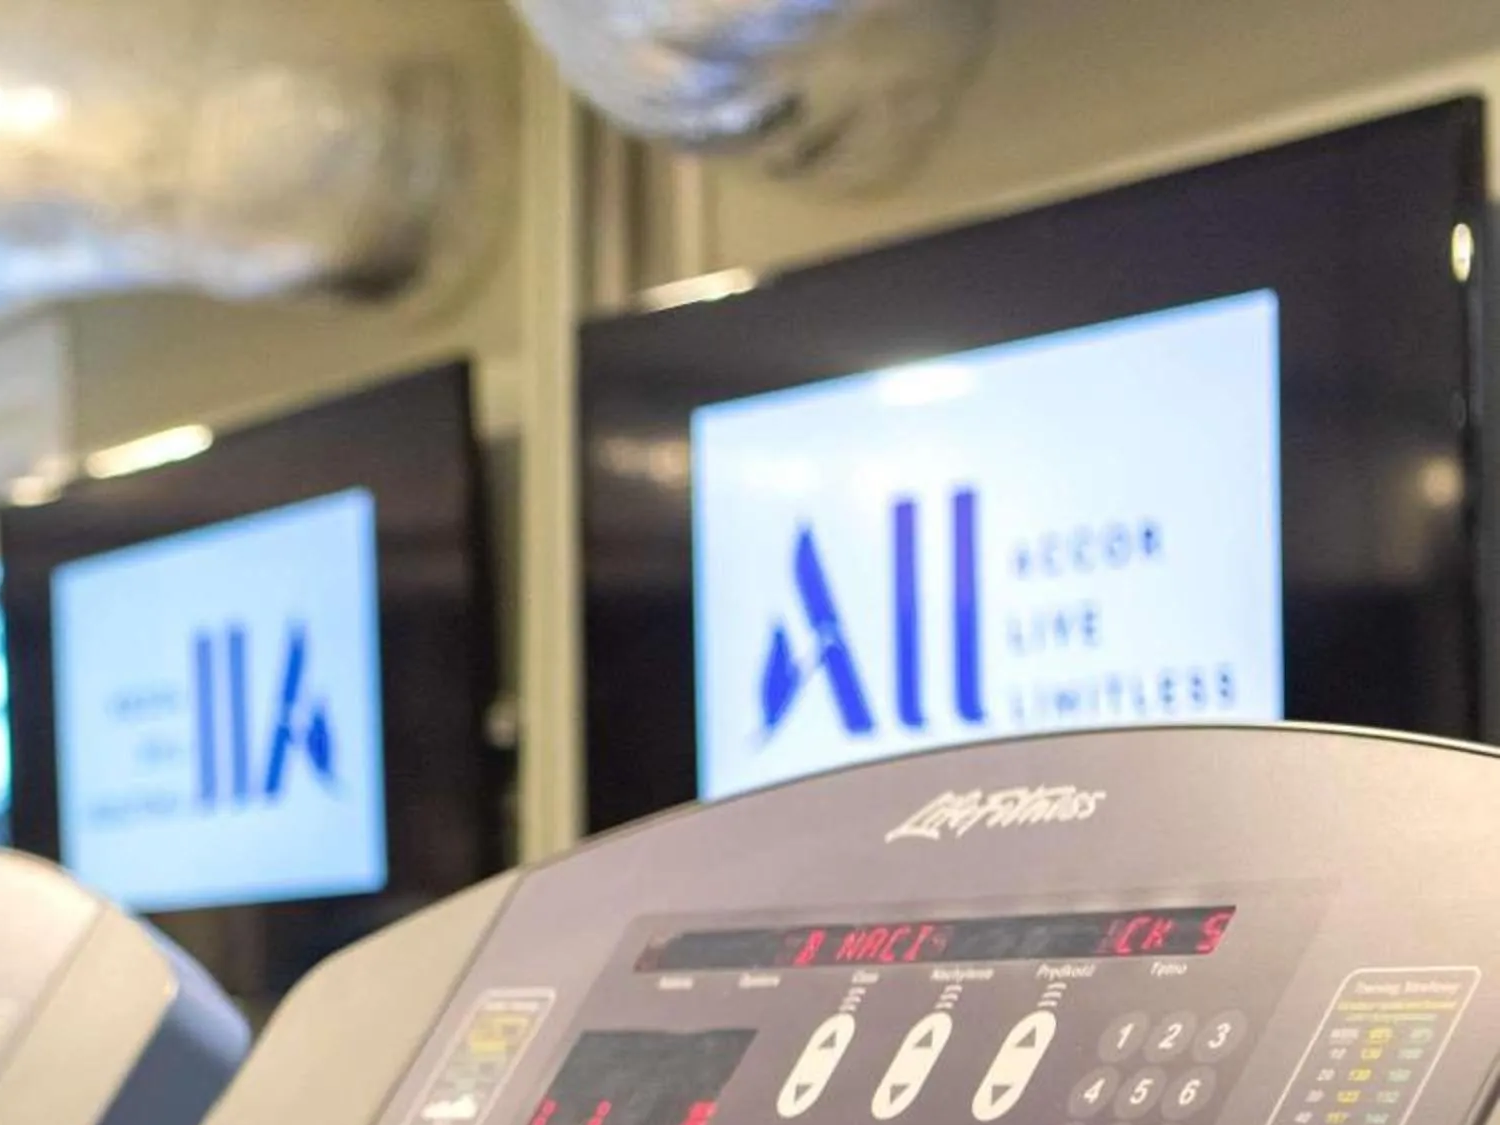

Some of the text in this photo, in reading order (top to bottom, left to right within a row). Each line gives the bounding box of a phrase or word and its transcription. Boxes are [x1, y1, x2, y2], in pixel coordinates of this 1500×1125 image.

[1008, 602, 1102, 657] LIVE
[1116, 1022, 1233, 1050] 1 2 3
[1082, 1077, 1202, 1106] 4 5 6
